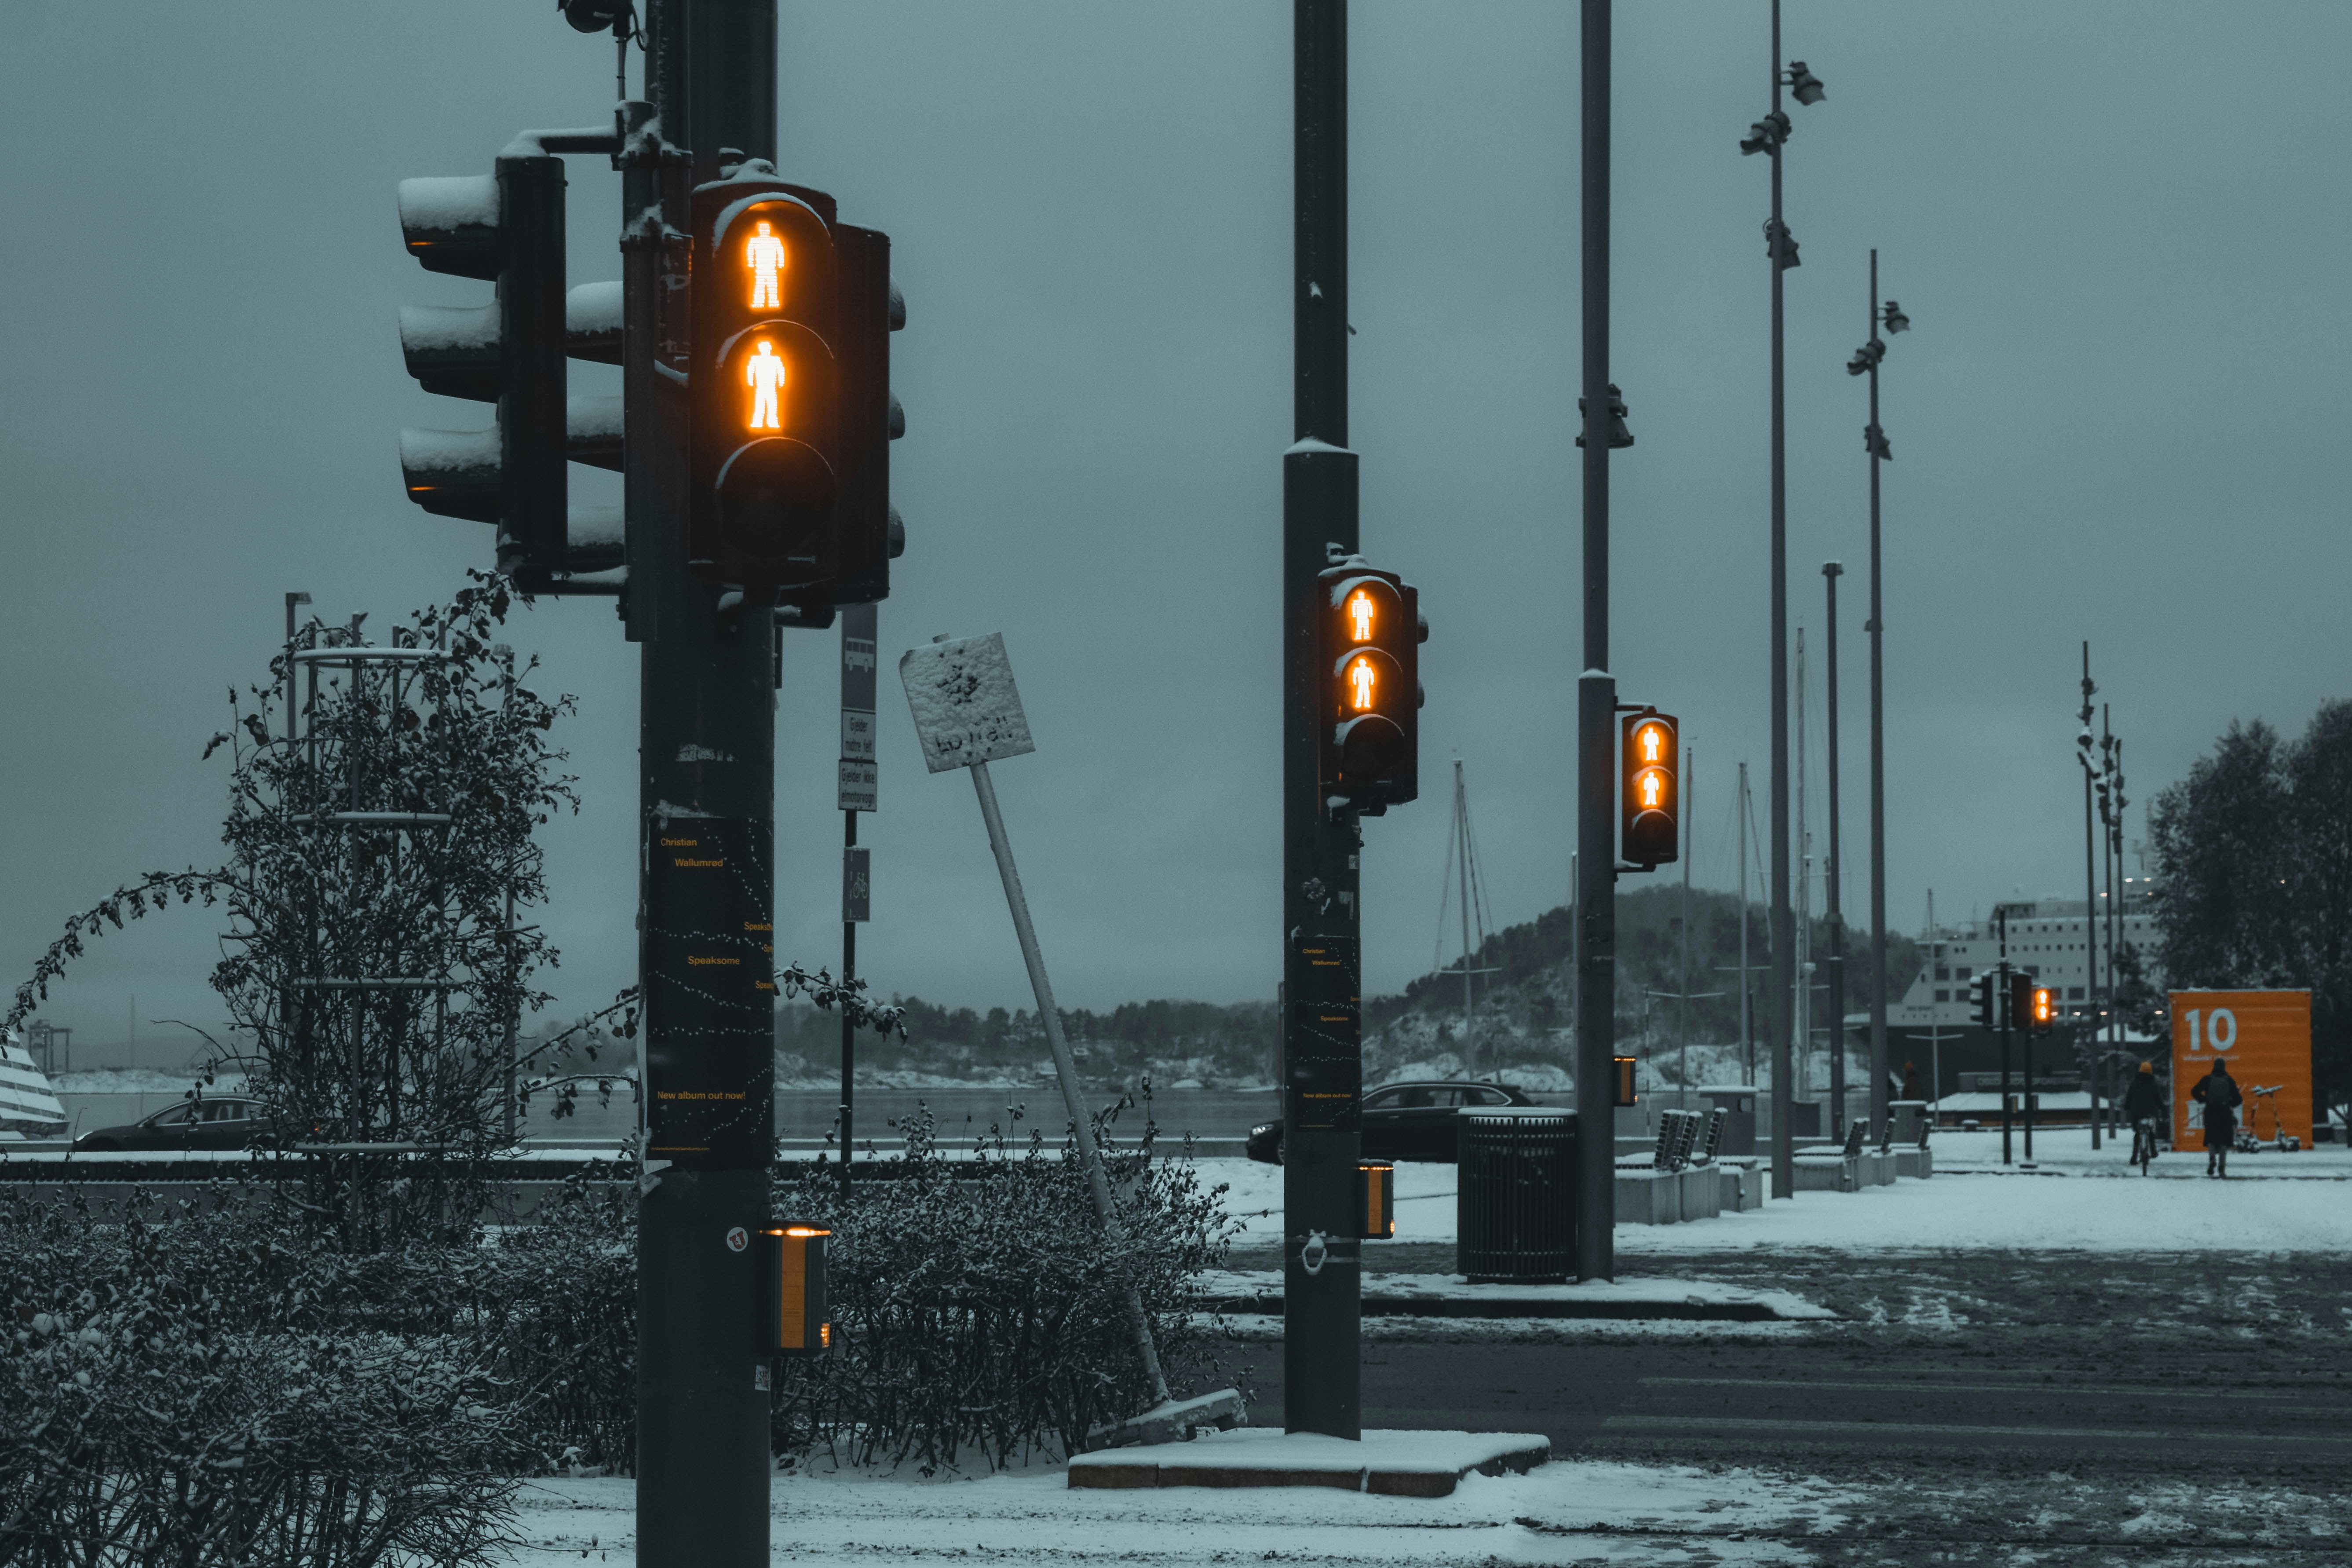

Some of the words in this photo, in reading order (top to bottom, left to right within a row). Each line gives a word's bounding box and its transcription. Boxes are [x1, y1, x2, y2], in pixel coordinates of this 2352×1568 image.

[850, 717, 868, 735] Gjelder
[863, 738, 873, 753] felt
[841, 767, 862, 786] Gjelder
[864, 770, 875, 784] ikke
[841, 789, 875, 808] elmotorvogn
[661, 838, 697, 846] Christian
[675, 858, 723, 867] Wallumrød
[688, 955, 740, 966] Speaksome
[2184, 1007, 2237, 1051] 10
[657, 1091, 676, 1100] New
[678, 1091, 706, 1100] album
[708, 1091, 723, 1100] out
[725, 1091, 746, 1100] now!
